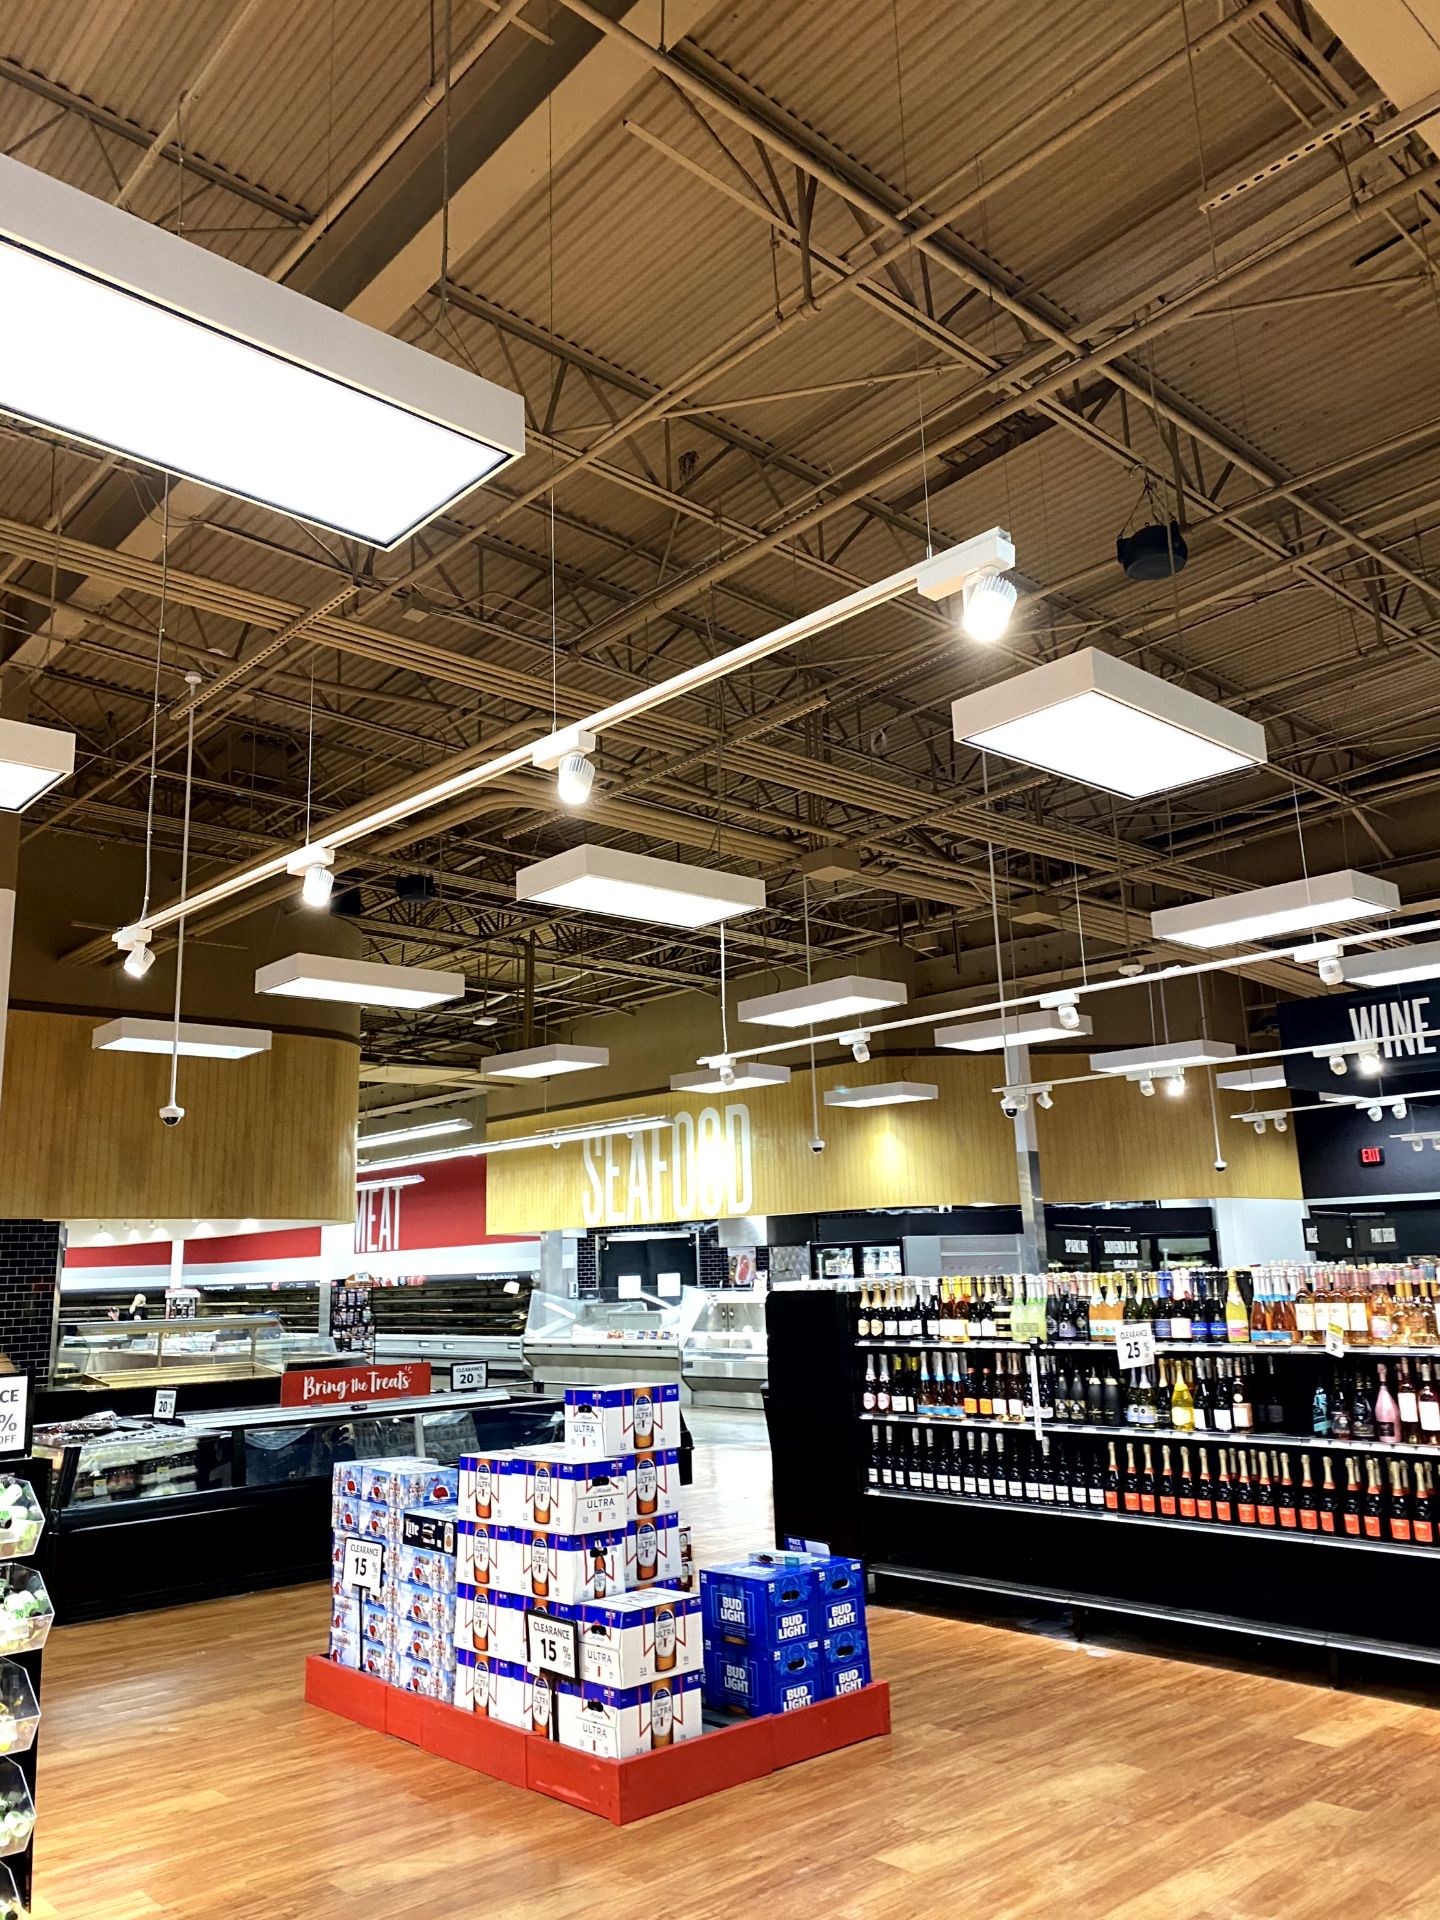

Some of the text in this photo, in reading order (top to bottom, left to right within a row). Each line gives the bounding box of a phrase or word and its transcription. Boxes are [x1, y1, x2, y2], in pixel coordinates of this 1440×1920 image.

[1349, 997, 1436, 1058] WINE
[1363, 1148, 1380, 1163] EXIT
[582, 1104, 752, 1225] SEAFOOD
[355, 1185, 403, 1252] MEAT
[1126, 1341, 1141, 1359] 25
[304, 1370, 411, 1400] Bring the Treats
[460, 1373, 474, 1384] 20
[158, 1401, 168, 1412] 20
[573, 1425, 595, 1434] ULTRA
[586, 1498, 615, 1508] ULTRA
[350, 1544, 379, 1557] CLEARANCE
[355, 1557, 367, 1576] 15
[722, 1597, 742, 1611] BUD
[832, 1603, 852, 1616] BUD
[720, 1607, 745, 1624] LIGHT
[781, 1614, 803, 1628] BUD
[828, 1612, 856, 1628] LIGHT
[533, 1621, 570, 1640] CLEARANCE
[778, 1623, 806, 1639] LIGHT
[541, 1638, 571, 1661] 15 %
[587, 1649, 612, 1663] ULTRA
[726, 1665, 746, 1679] BUD
[838, 1669, 858, 1683] BUD
[724, 1676, 748, 1693] LIGHT
[835, 1678, 863, 1696] LIGHT
[786, 1685, 808, 1700] BUD
[783, 1693, 812, 1713] LIGHT
[582, 1723, 607, 1738] ULTRA
